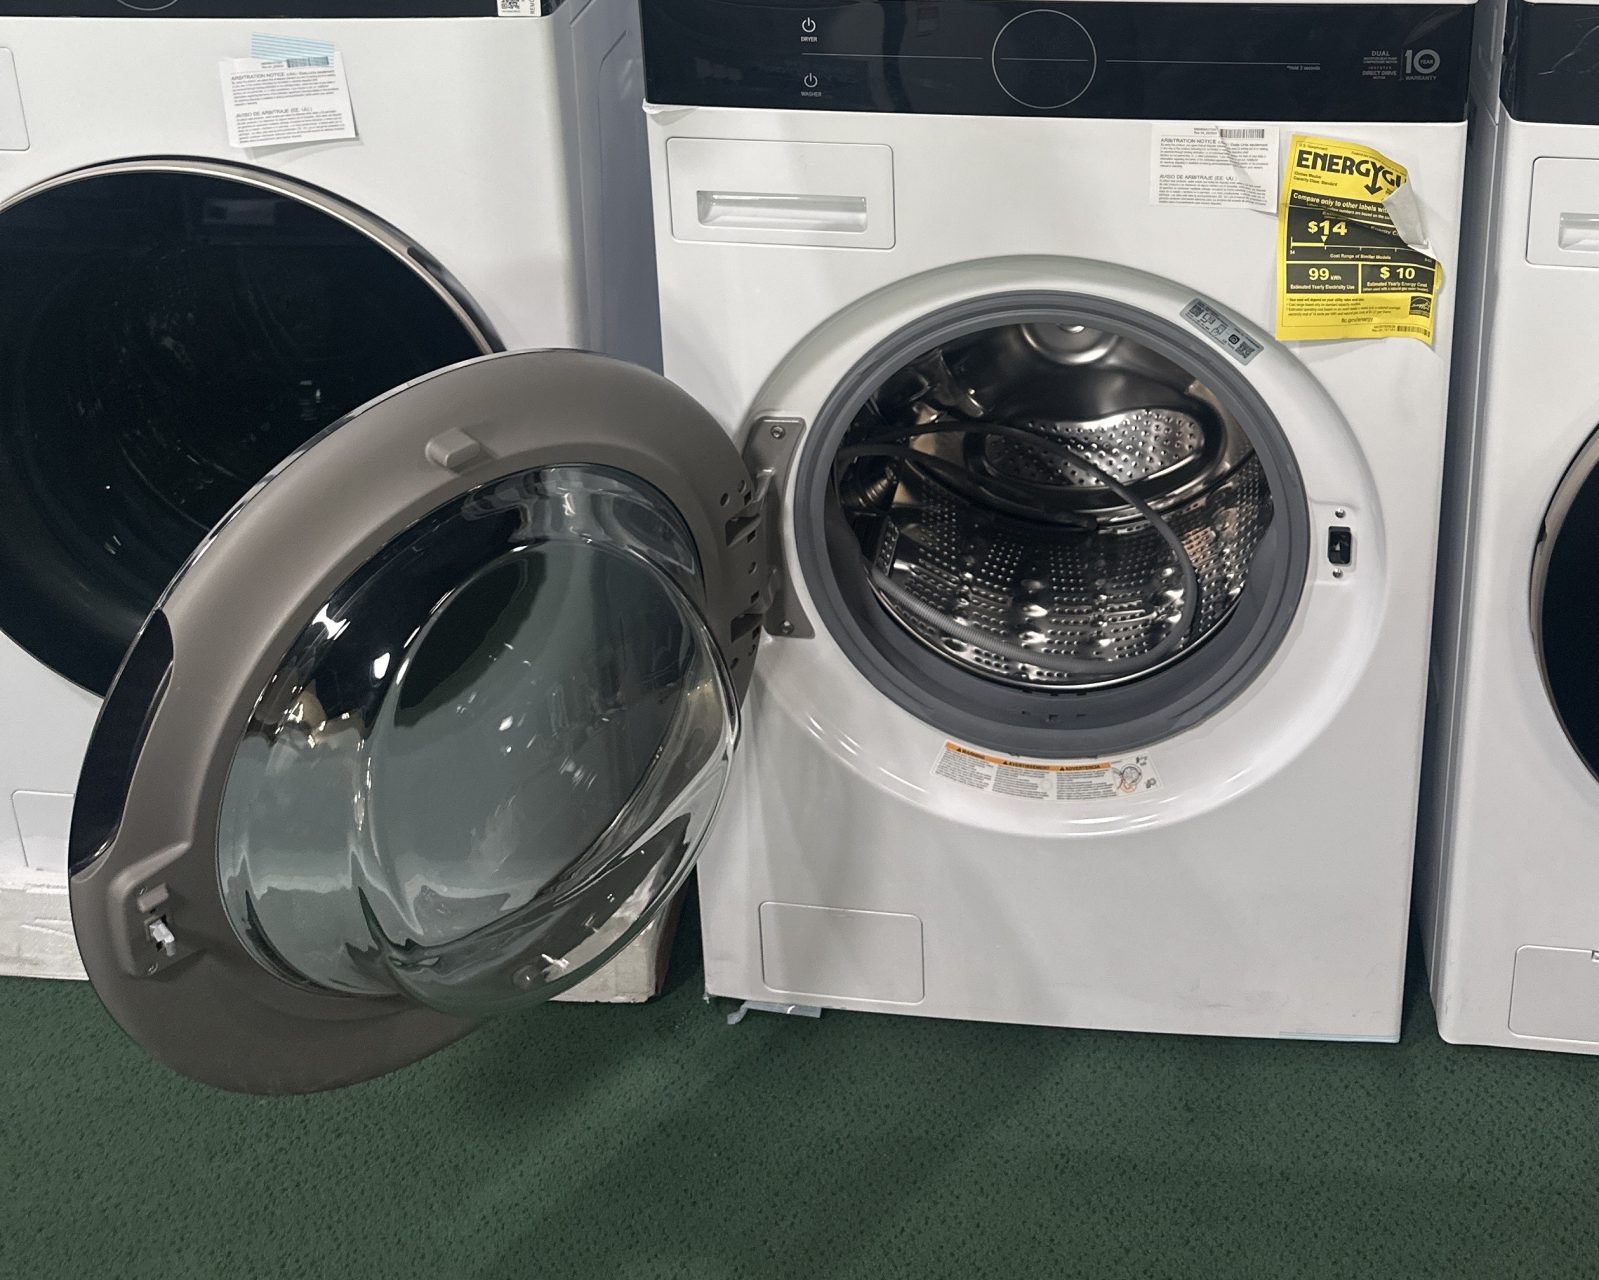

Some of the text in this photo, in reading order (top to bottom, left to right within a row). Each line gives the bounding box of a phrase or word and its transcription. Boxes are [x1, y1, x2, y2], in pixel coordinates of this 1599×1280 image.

[1405, 49, 1440, 74] 10
[1293, 193, 1320, 204] Compare
[1321, 198, 1334, 206] only
[1359, 203, 1376, 211] labels
[1307, 220, 1348, 235] $14
[1308, 267, 1329, 280] 99
[1380, 266, 1415, 279] $ 10
